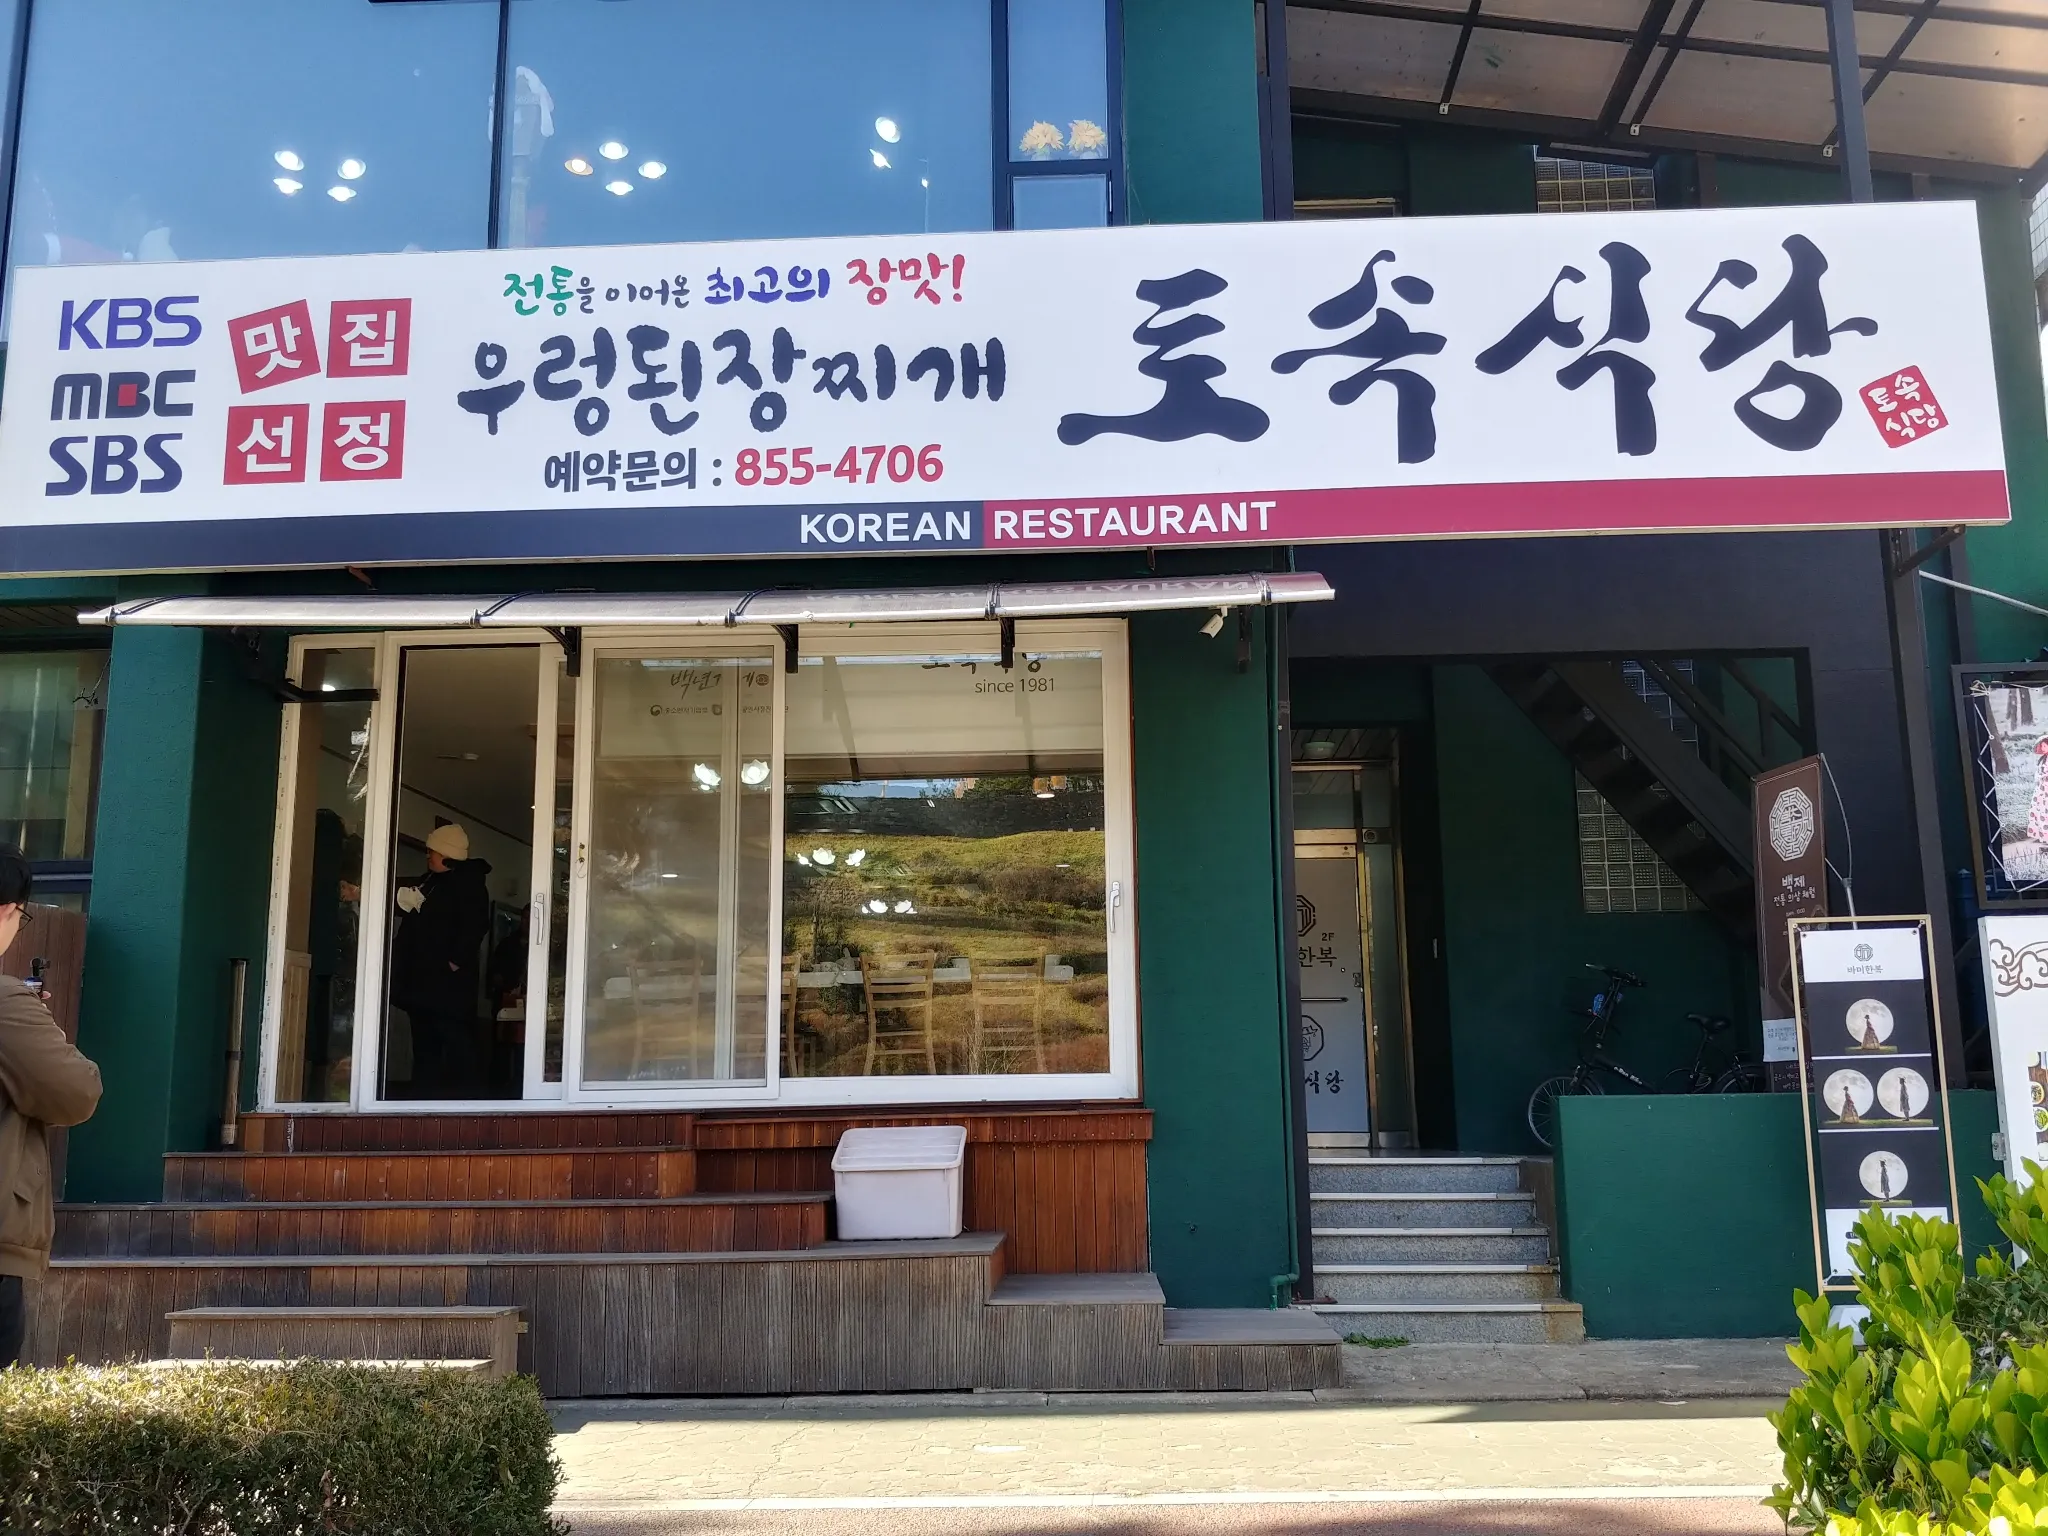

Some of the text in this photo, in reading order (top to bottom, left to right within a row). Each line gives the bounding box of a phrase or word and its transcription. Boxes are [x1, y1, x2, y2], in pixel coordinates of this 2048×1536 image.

[503, 253, 965, 316] 전통을 이어온 최고의 장맛!
[58, 295, 202, 351] KBS
[242, 308, 396, 379] 맛집
[1057, 233, 1879, 464] 토속식당
[50, 369, 196, 420] MBC
[457, 325, 1007, 436] 우렁된장찌개
[1867, 374, 1920, 413] 토속
[236, 411, 391, 473] 선정
[1885, 403, 1940, 438] 식당
[45, 432, 183, 496] SBS
[544, 448, 697, 493] 예약문의
[734, 444, 944, 487] 855-4706
[800, 501, 1277, 544] KOREAN RESTAURANT
[975, 678, 1055, 693] since 1981
[1781, 874, 1806, 893] 백제
[1321, 932, 1335, 941] 2F
